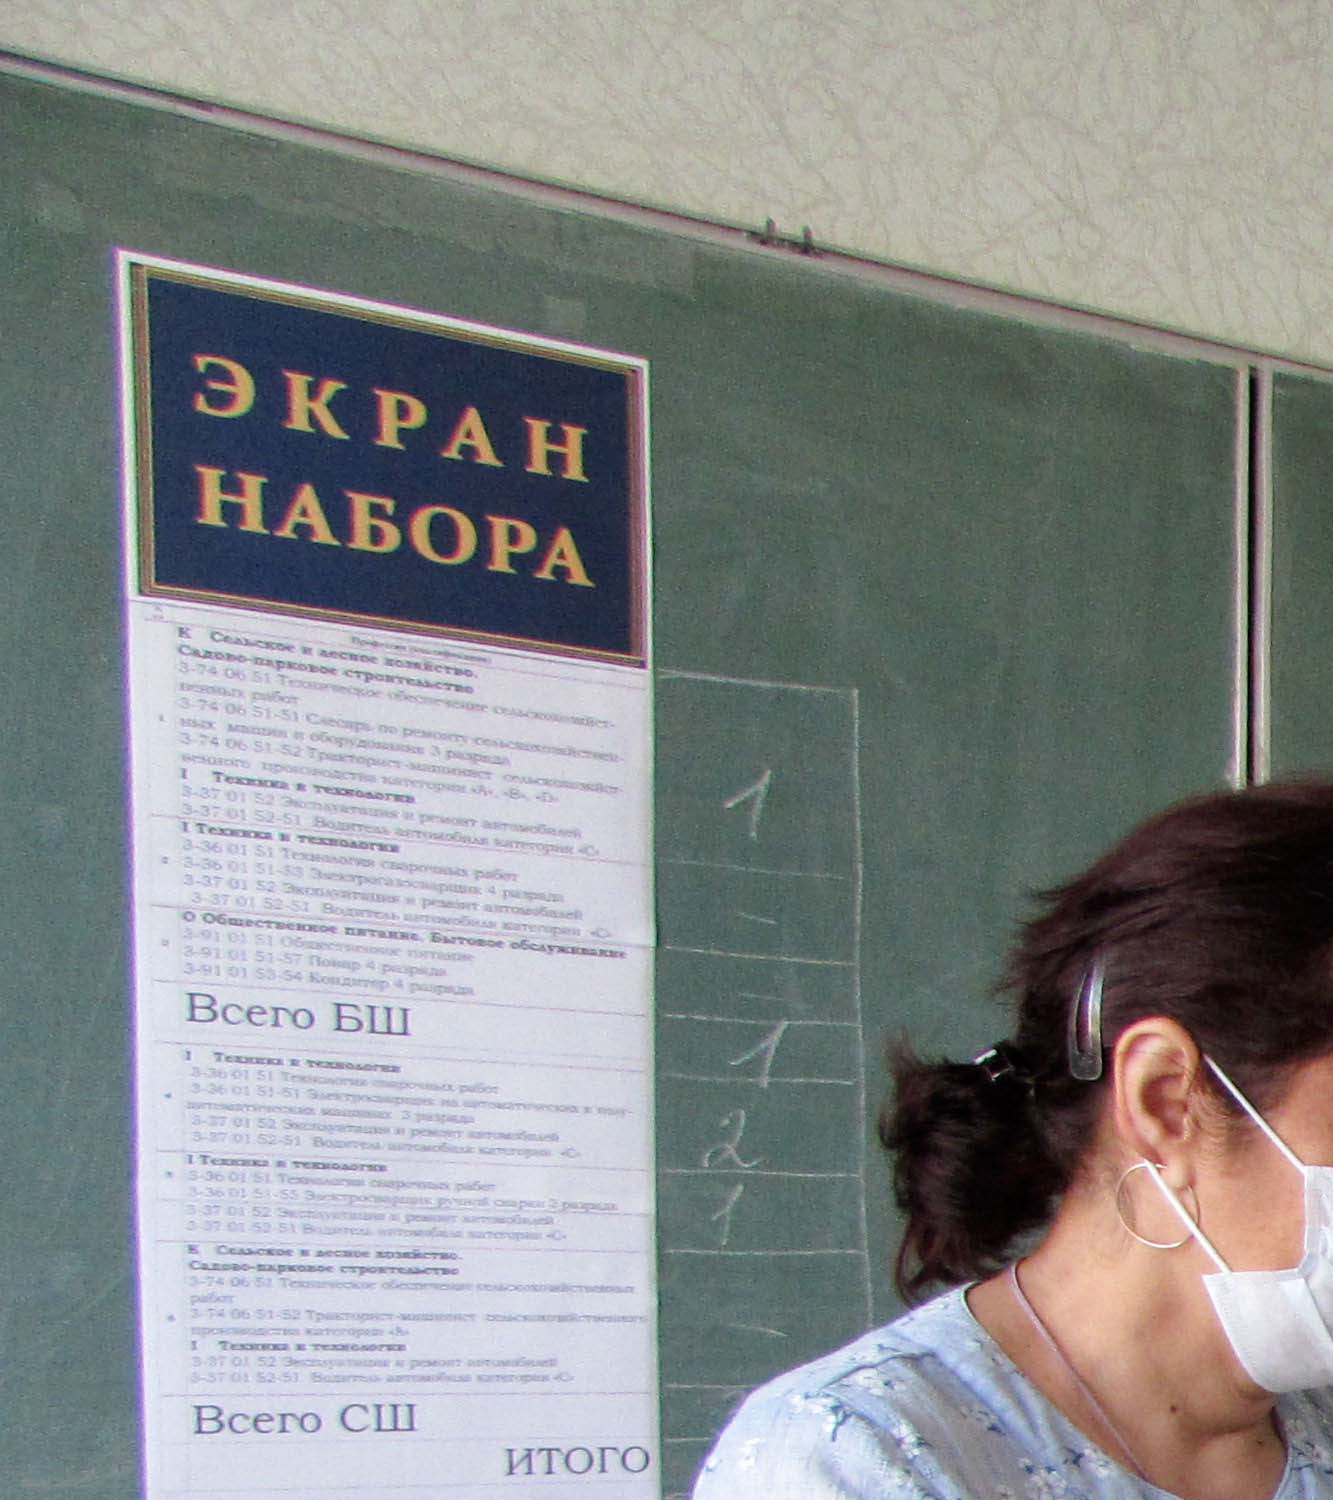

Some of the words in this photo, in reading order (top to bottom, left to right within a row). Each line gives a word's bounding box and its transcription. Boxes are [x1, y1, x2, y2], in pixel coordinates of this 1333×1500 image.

[193, 354, 589, 483] ЭКРАН
[195, 465, 596, 588] НАБОРА
[212, 769, 289, 790] Техника
[195, 821, 273, 841] Техника
[201, 911, 338, 934] Общественное
[429, 930, 504, 949] Бытовое
[185, 991, 316, 1030] Всего
[331, 1001, 412, 1036] БШ
[213, 1050, 284, 1066] Техника
[199, 1154, 269, 1168] Техника
[218, 1339, 289, 1352] Техника
[193, 1404, 324, 1435] Всего
[339, 1402, 418, 1433] СШ
[505, 1445, 651, 1477] ИТОГО
